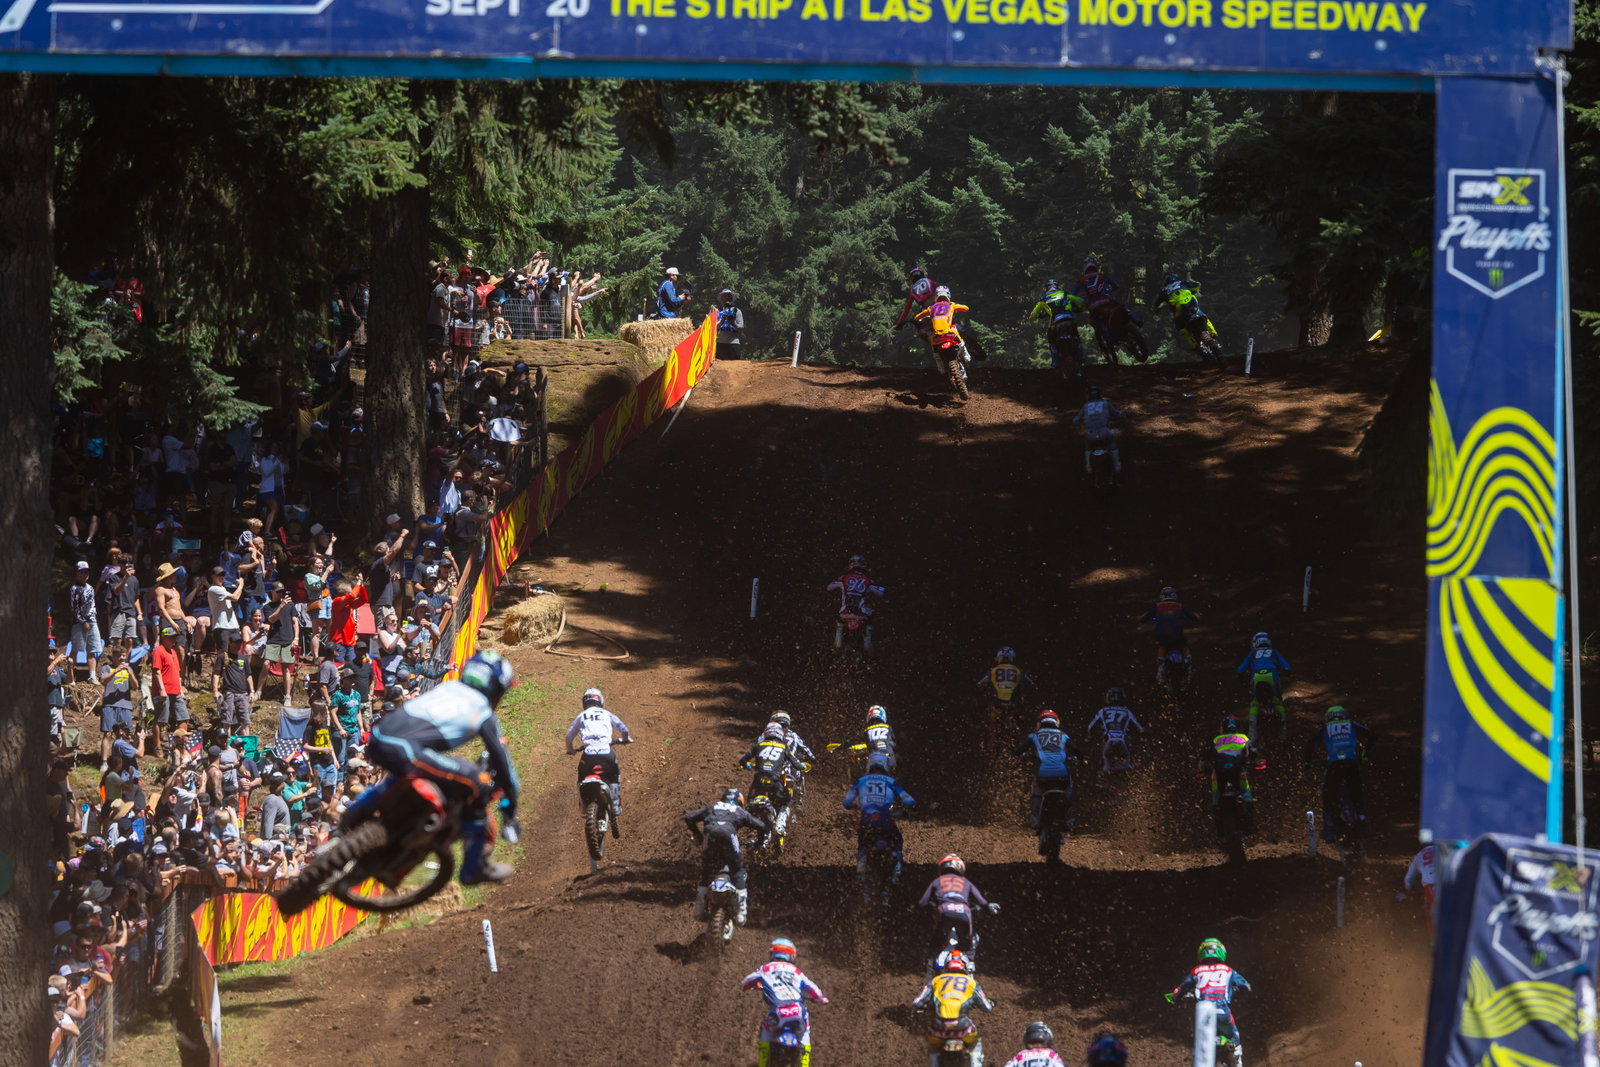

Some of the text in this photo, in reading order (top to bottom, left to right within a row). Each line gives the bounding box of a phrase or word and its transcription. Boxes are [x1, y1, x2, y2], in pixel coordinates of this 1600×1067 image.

[425, 0, 1428, 33] SEPT 20 THE STRIP AT LAS VEGAS MOTOR SPEEDWAY
[1437, 214, 1552, 261] Playoffs
[759, 746, 784, 761] 45
[939, 976, 968, 993] 78
